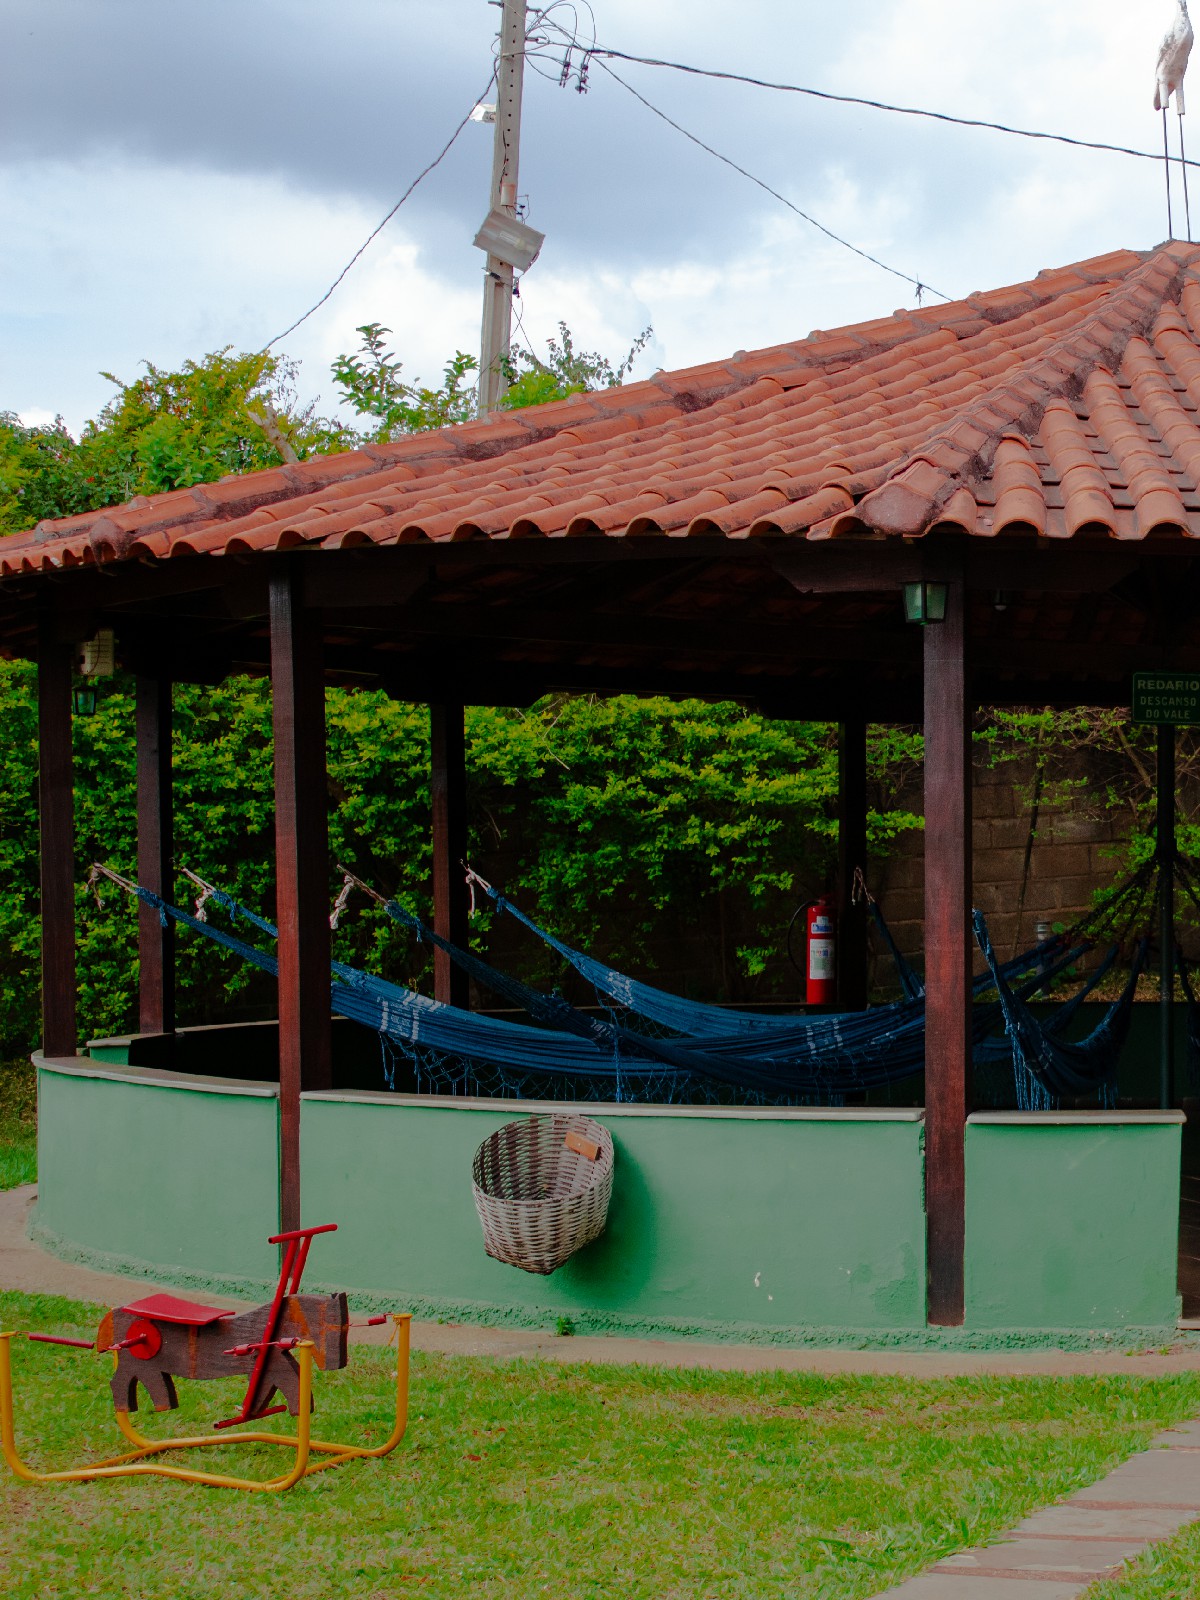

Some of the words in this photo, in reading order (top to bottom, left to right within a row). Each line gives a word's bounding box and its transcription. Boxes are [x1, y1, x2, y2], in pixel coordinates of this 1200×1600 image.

[1137, 679, 1200, 691] REDARIO
[1140, 696, 1197, 707] DESCANSO
[1146, 709, 1160, 719] DO
[1163, 709, 1191, 719] VALE
